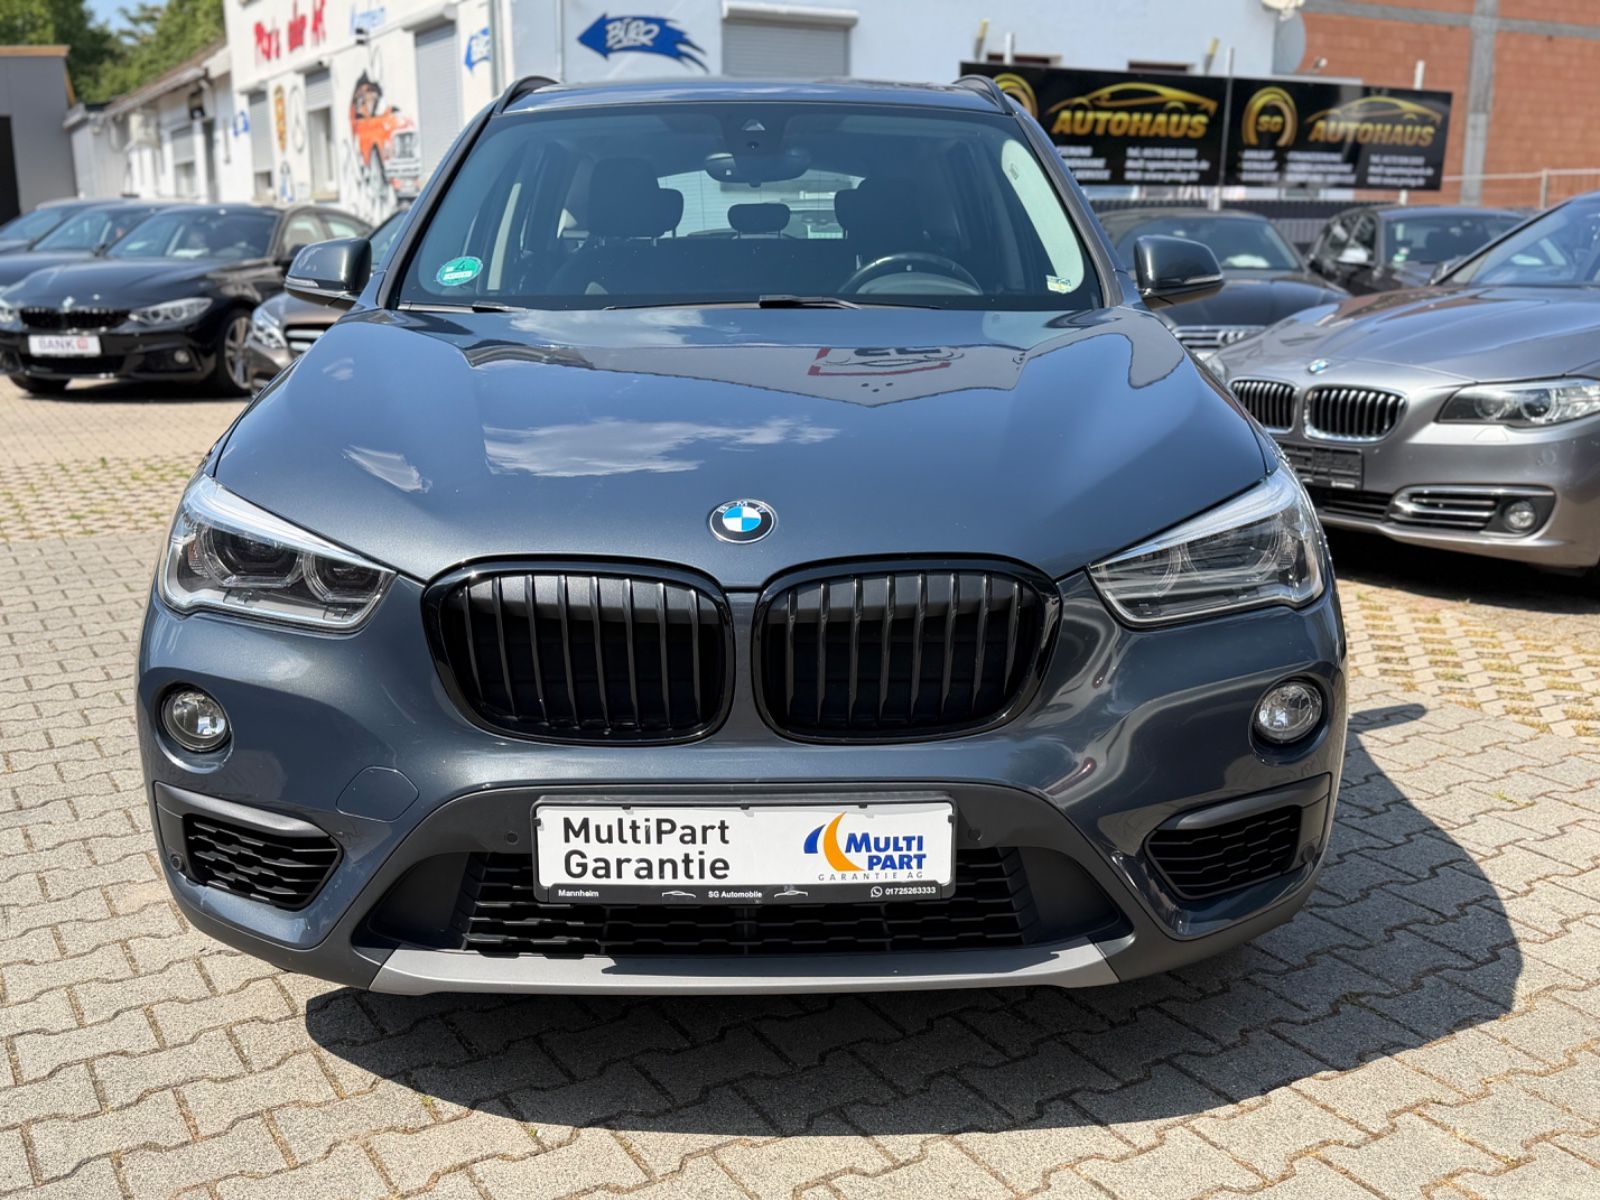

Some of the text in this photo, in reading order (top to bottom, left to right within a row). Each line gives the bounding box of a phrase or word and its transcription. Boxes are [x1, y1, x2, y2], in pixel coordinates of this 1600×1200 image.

[1052, 110, 1209, 138] AUTOHAUS
[1256, 115, 1284, 132] SG
[1308, 120, 1435, 146] AUTOHAUS
[563, 817, 730, 845] MultiPart
[845, 832, 924, 853] MULTI
[564, 849, 730, 880] Garantie
[868, 854, 927, 871] PART
[818, 871, 923, 881] GARANTIE AG
[558, 889, 599, 897] Mannheim
